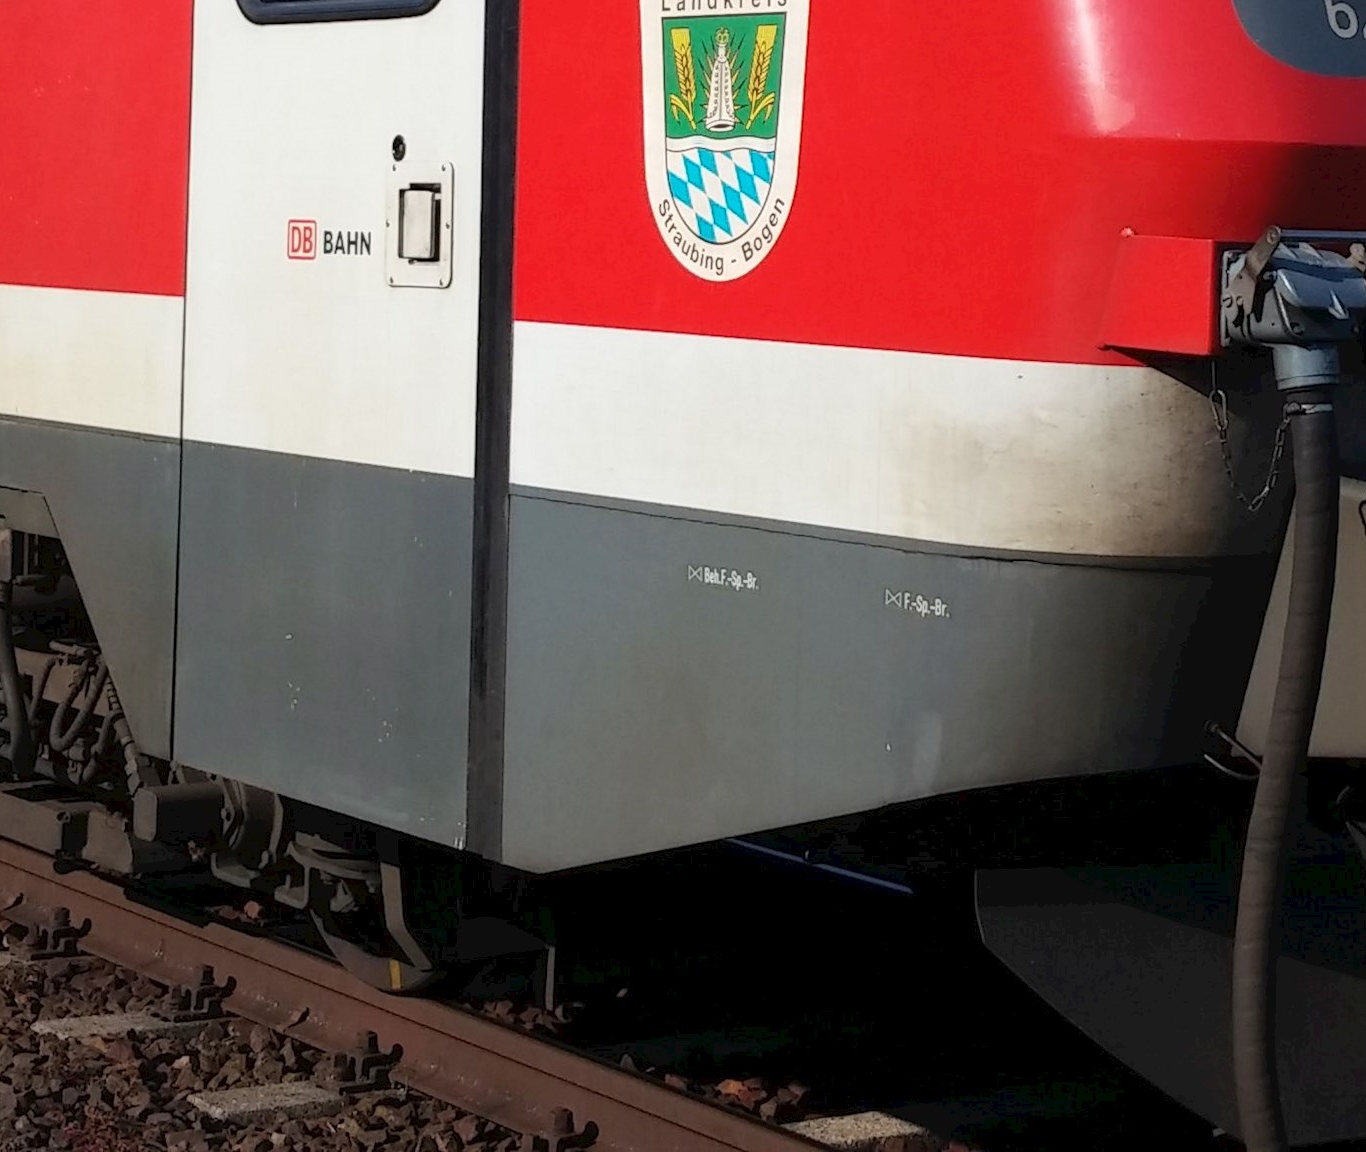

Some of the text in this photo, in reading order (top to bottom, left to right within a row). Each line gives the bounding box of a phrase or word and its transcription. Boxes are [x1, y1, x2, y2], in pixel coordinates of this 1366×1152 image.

[290, 225, 372, 256] DB BAHN
[658, 199, 725, 276] Straubing
[742, 199, 785, 263] Bogen
